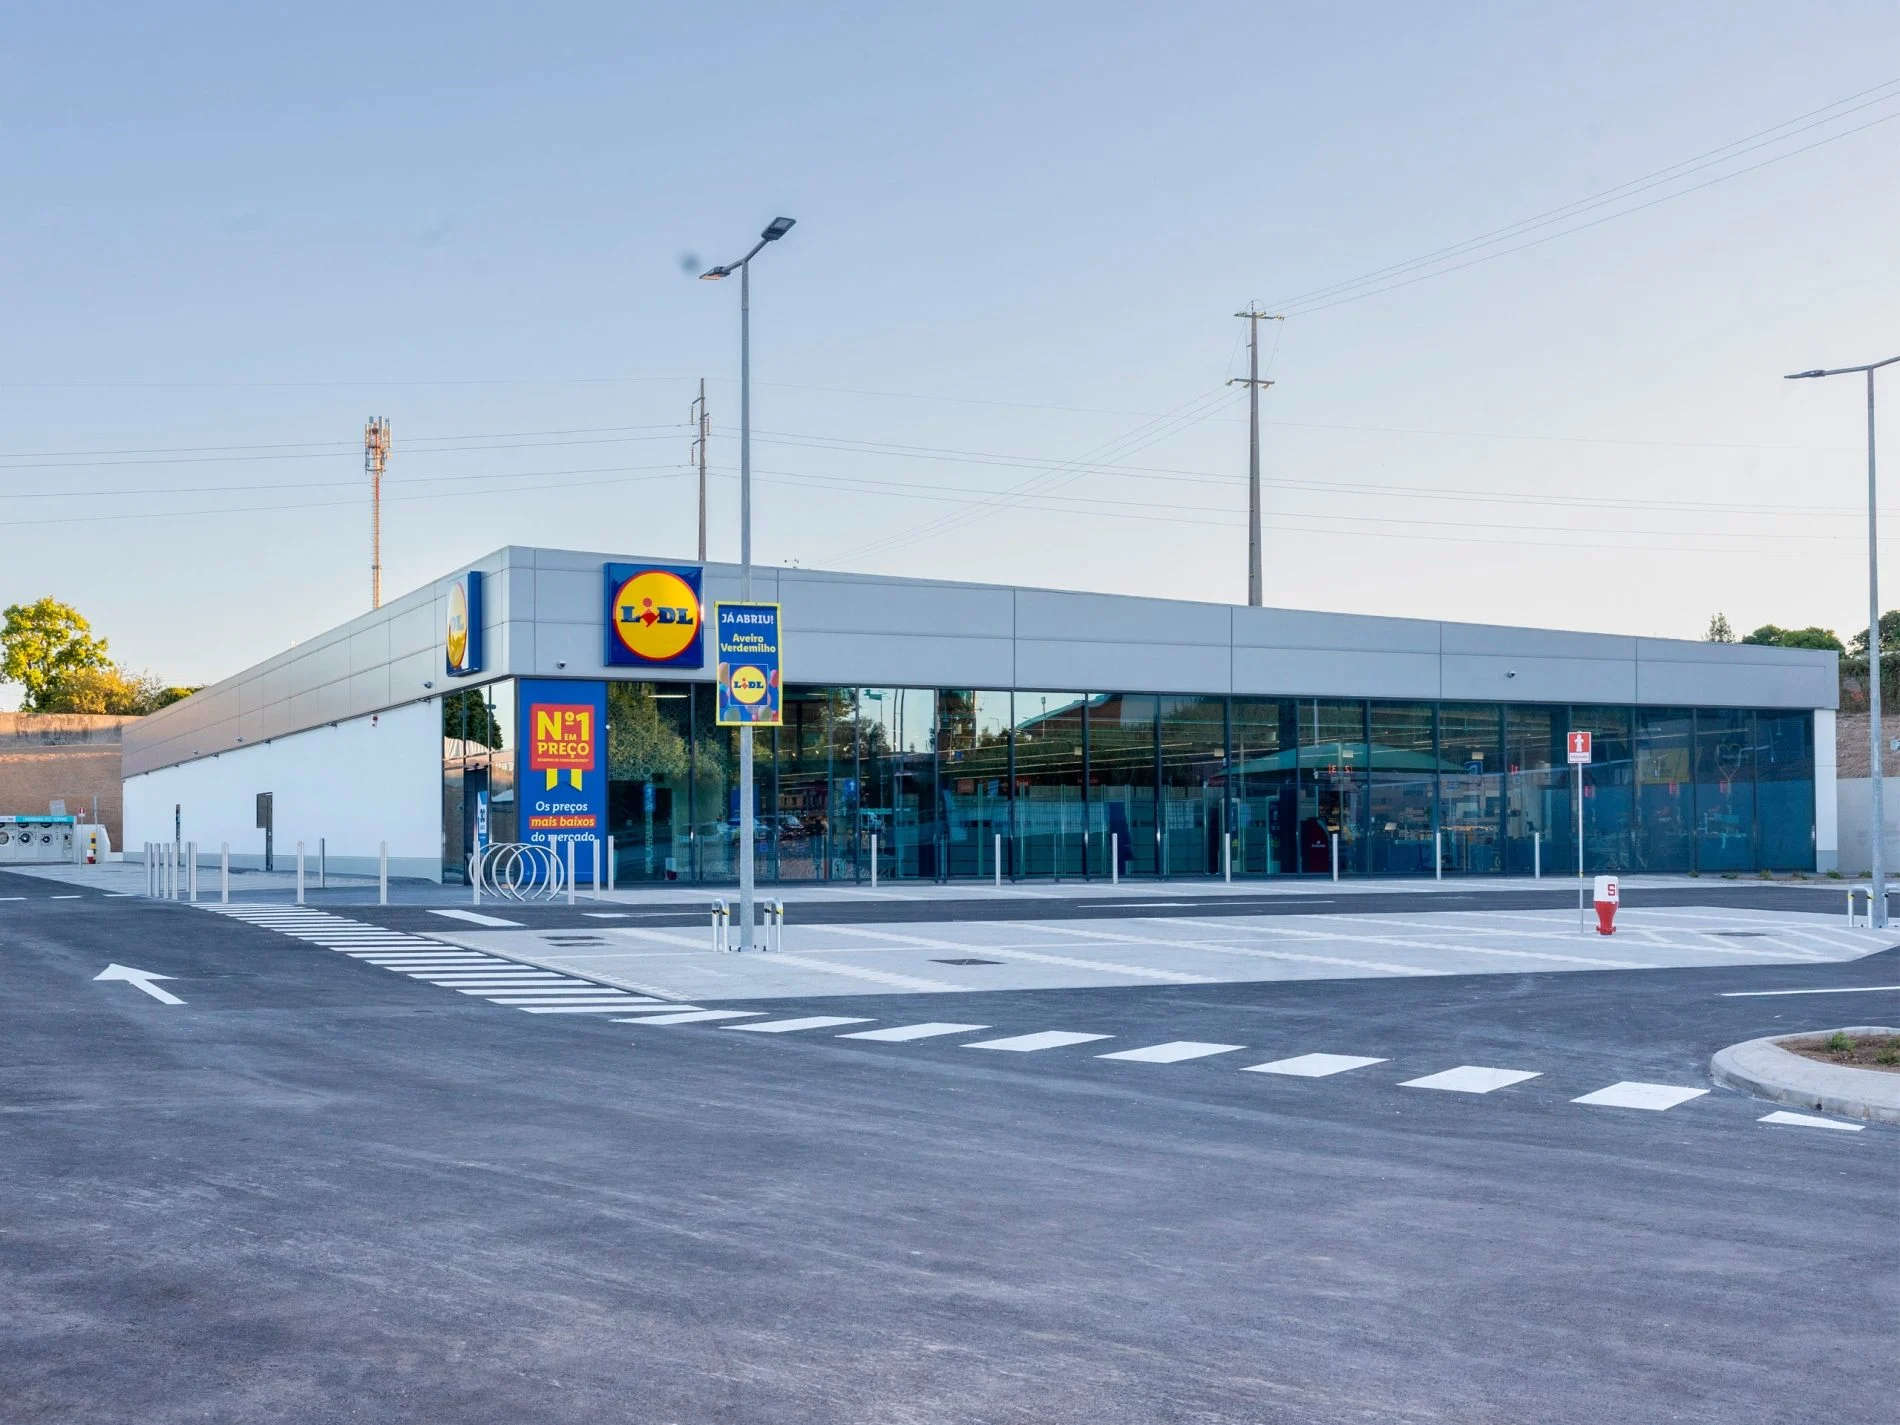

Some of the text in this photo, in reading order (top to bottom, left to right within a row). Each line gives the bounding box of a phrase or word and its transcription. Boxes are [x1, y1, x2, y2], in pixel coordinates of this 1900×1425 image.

[722, 612, 774, 625] JÁ ABRIU!
[732, 633, 764, 643] Aveiro
[720, 643, 776, 654] Verdemilho
[564, 733, 577, 741] EM
[537, 742, 590, 758] PREÇO
[535, 801, 588, 814] Os preços
[531, 816, 595, 827] mais baixos
[531, 832, 545, 842] do
[1607, 883, 1616, 896] S
